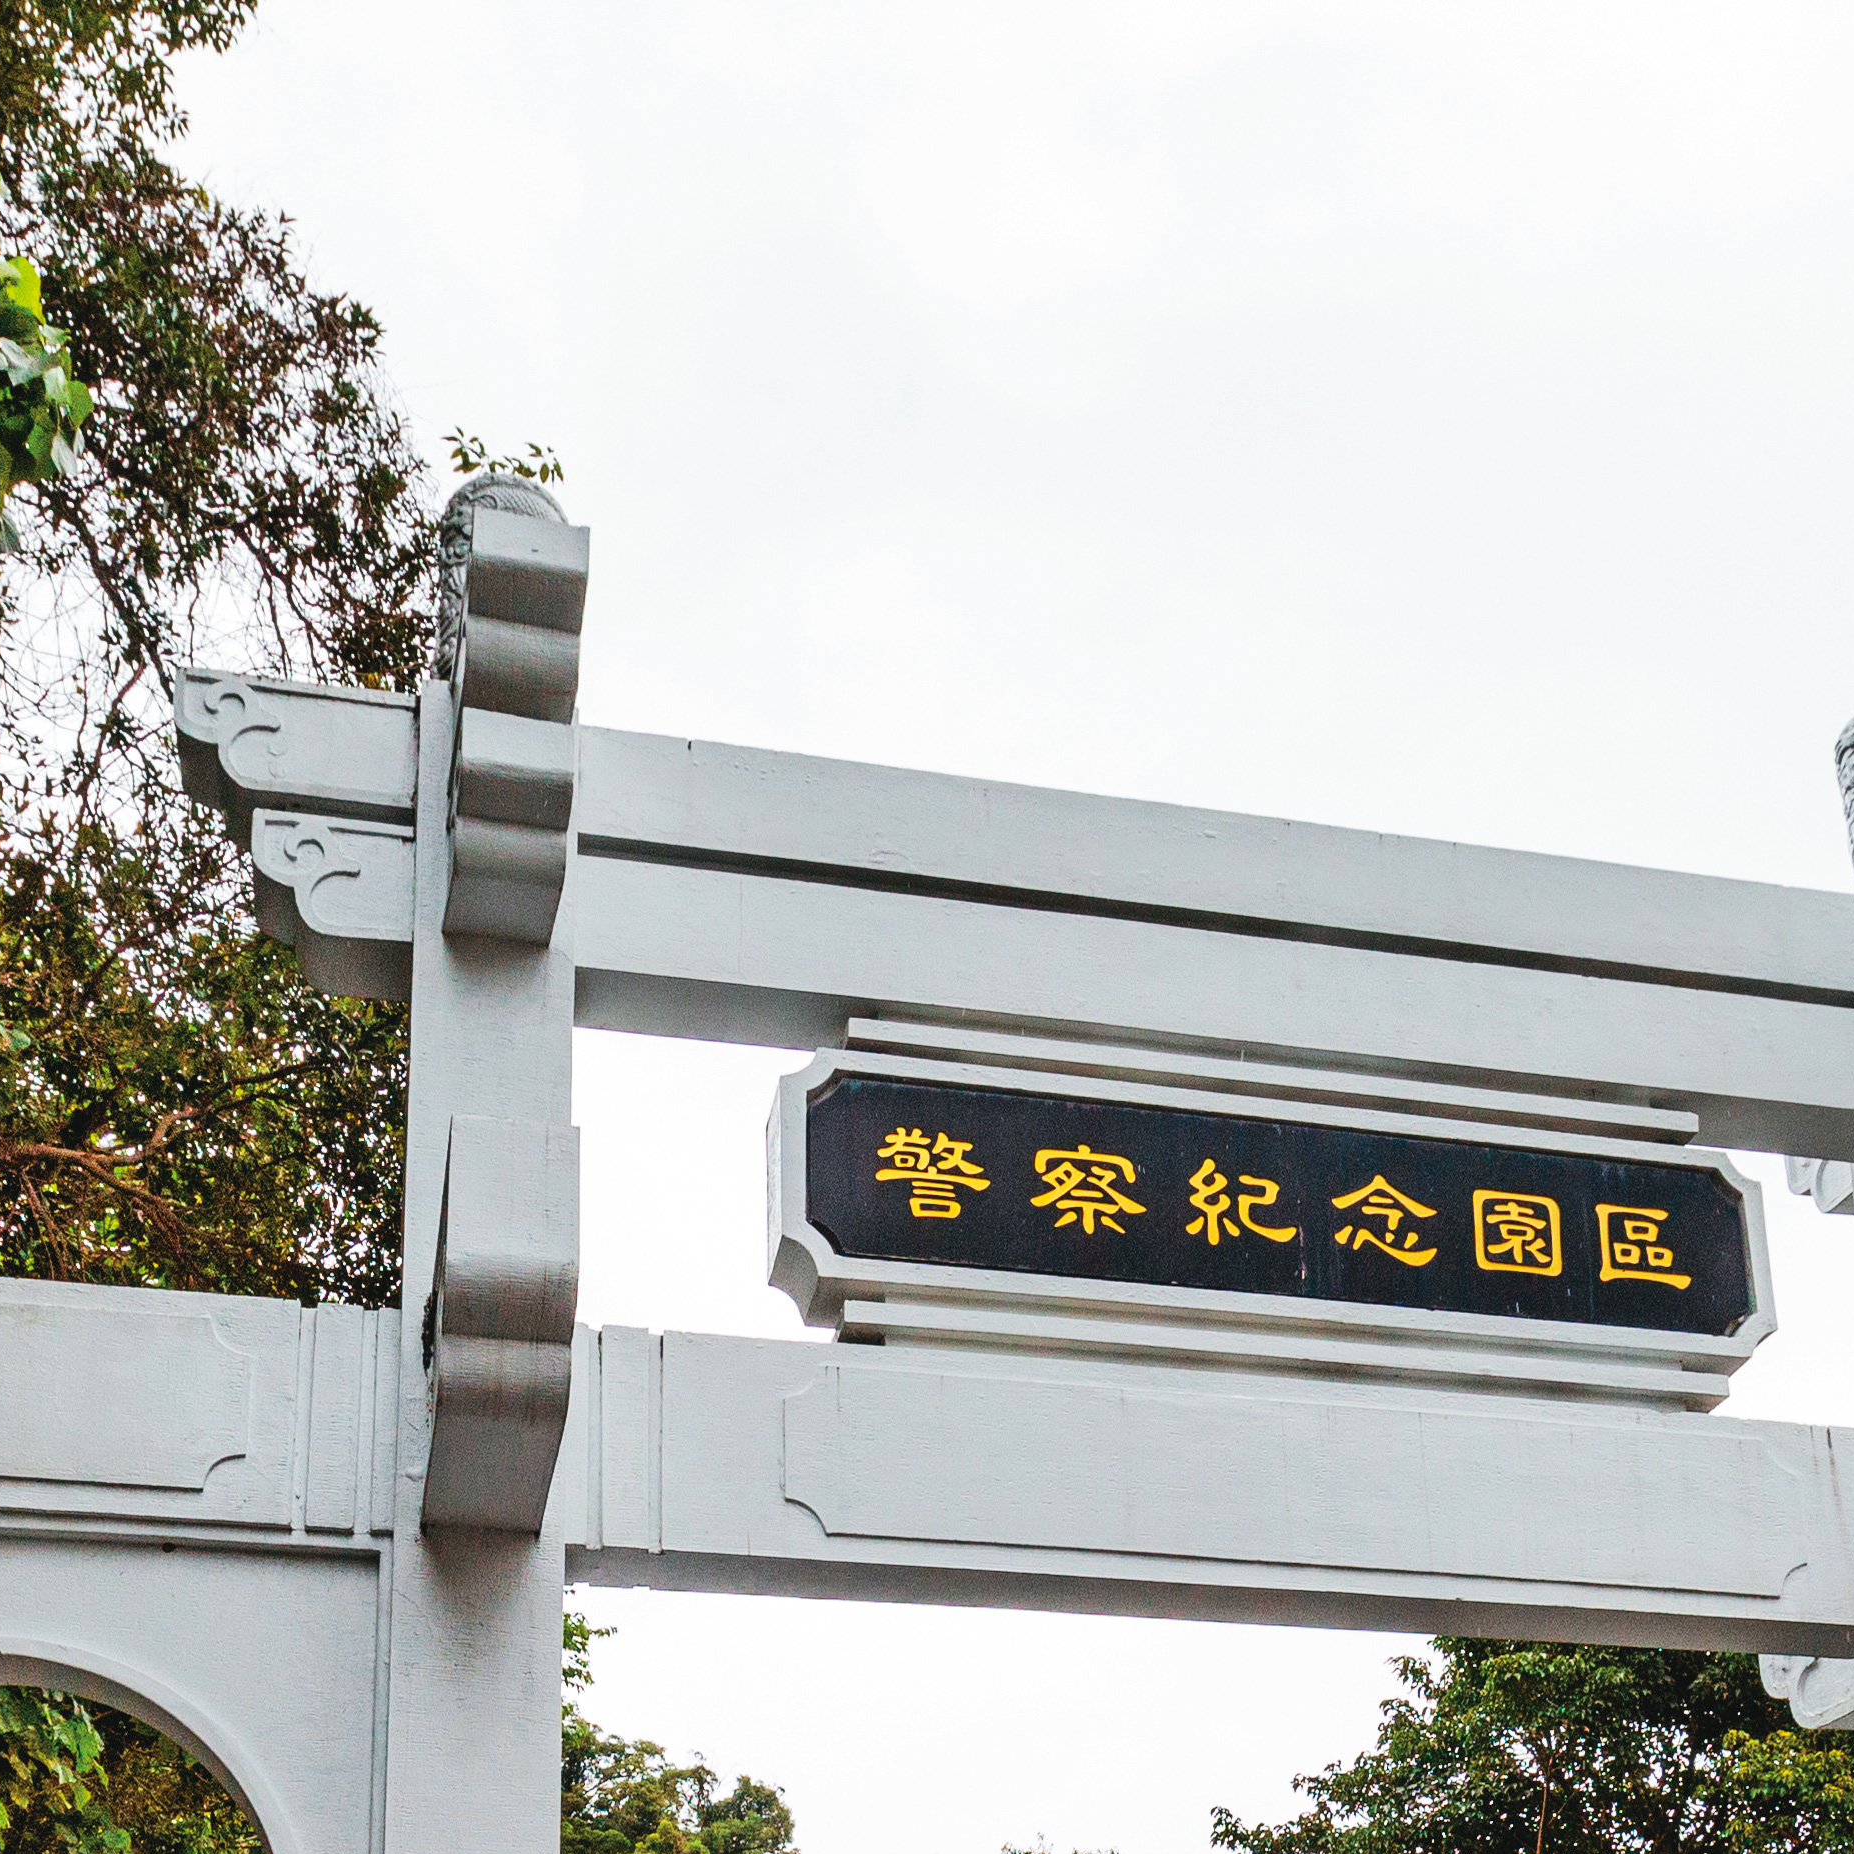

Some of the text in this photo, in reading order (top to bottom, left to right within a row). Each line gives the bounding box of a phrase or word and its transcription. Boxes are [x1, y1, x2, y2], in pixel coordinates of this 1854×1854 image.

[874, 1126, 1692, 1290] 警察紀念園區
